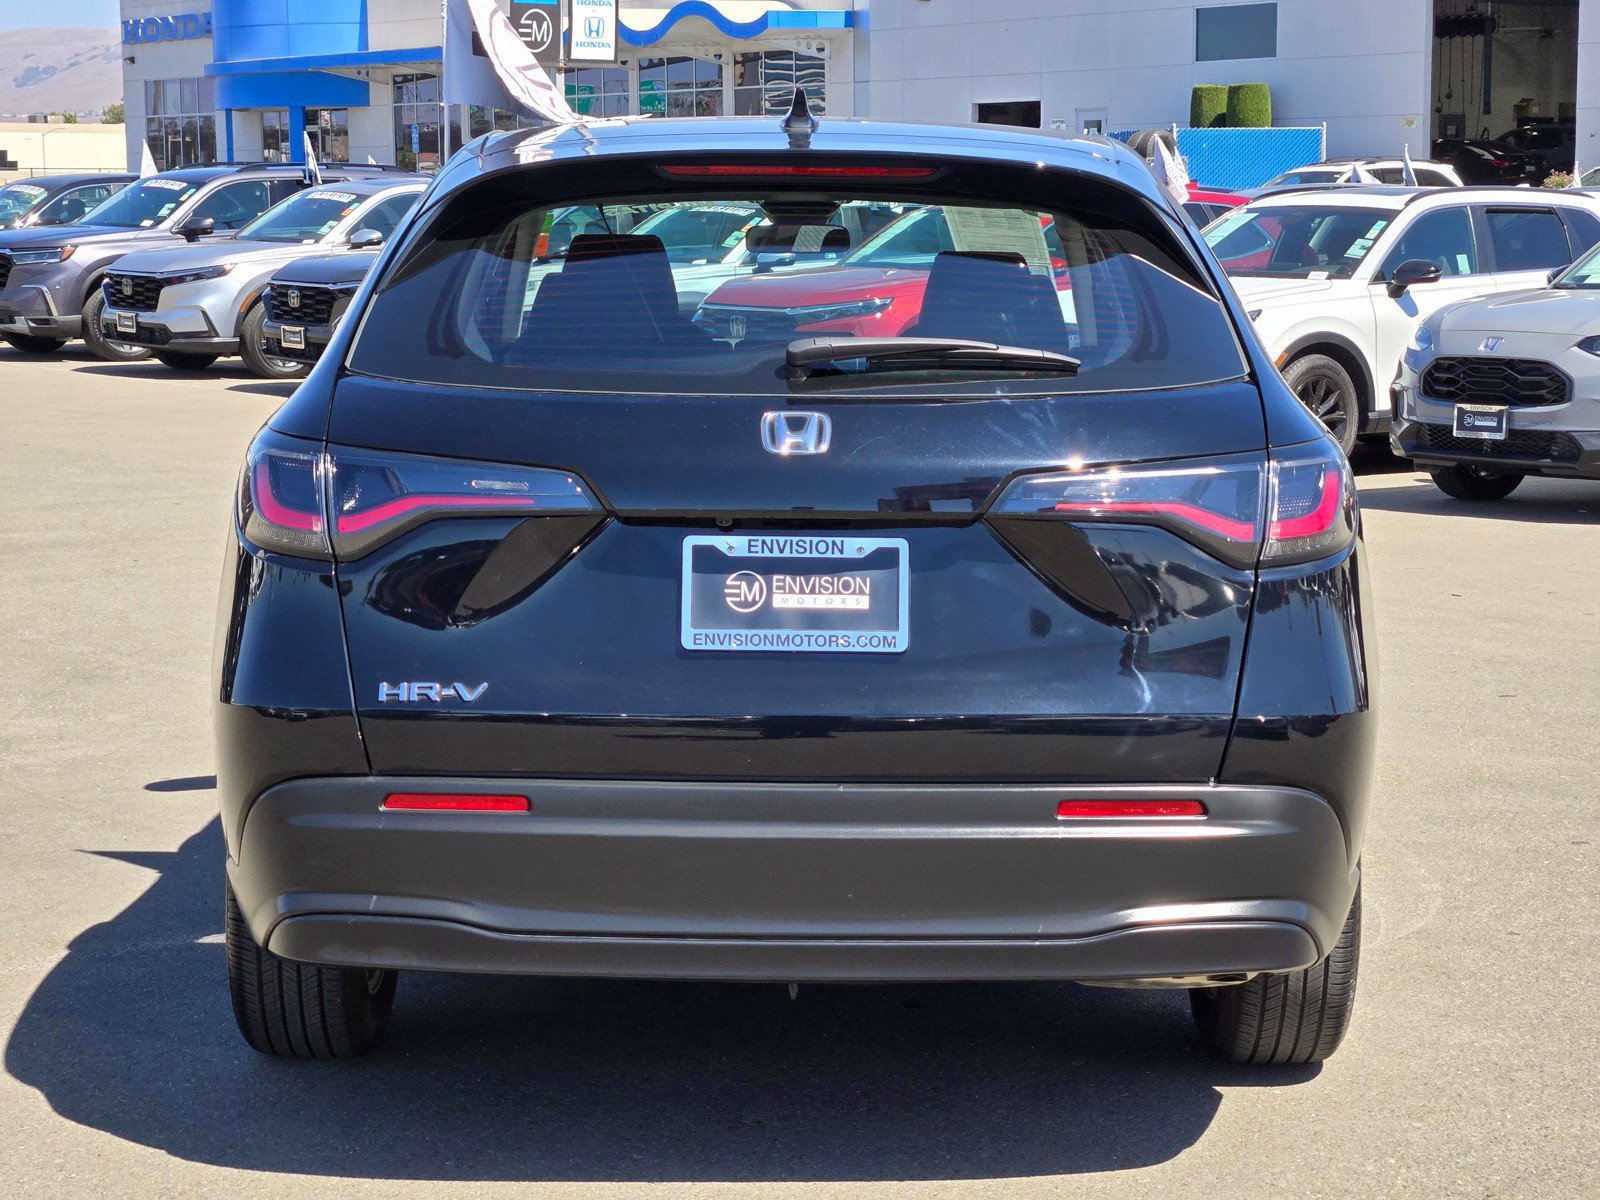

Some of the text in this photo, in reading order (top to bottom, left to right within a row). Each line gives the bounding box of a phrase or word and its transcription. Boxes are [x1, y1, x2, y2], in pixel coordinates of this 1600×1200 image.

[747, 538, 845, 555] ENVISION
[772, 575, 870, 595] ENVISION
[780, 597, 861, 606] MOTORS
[693, 632, 897, 649] ENVISIONMOTORS.COM
[378, 681, 489, 702] HR-V
